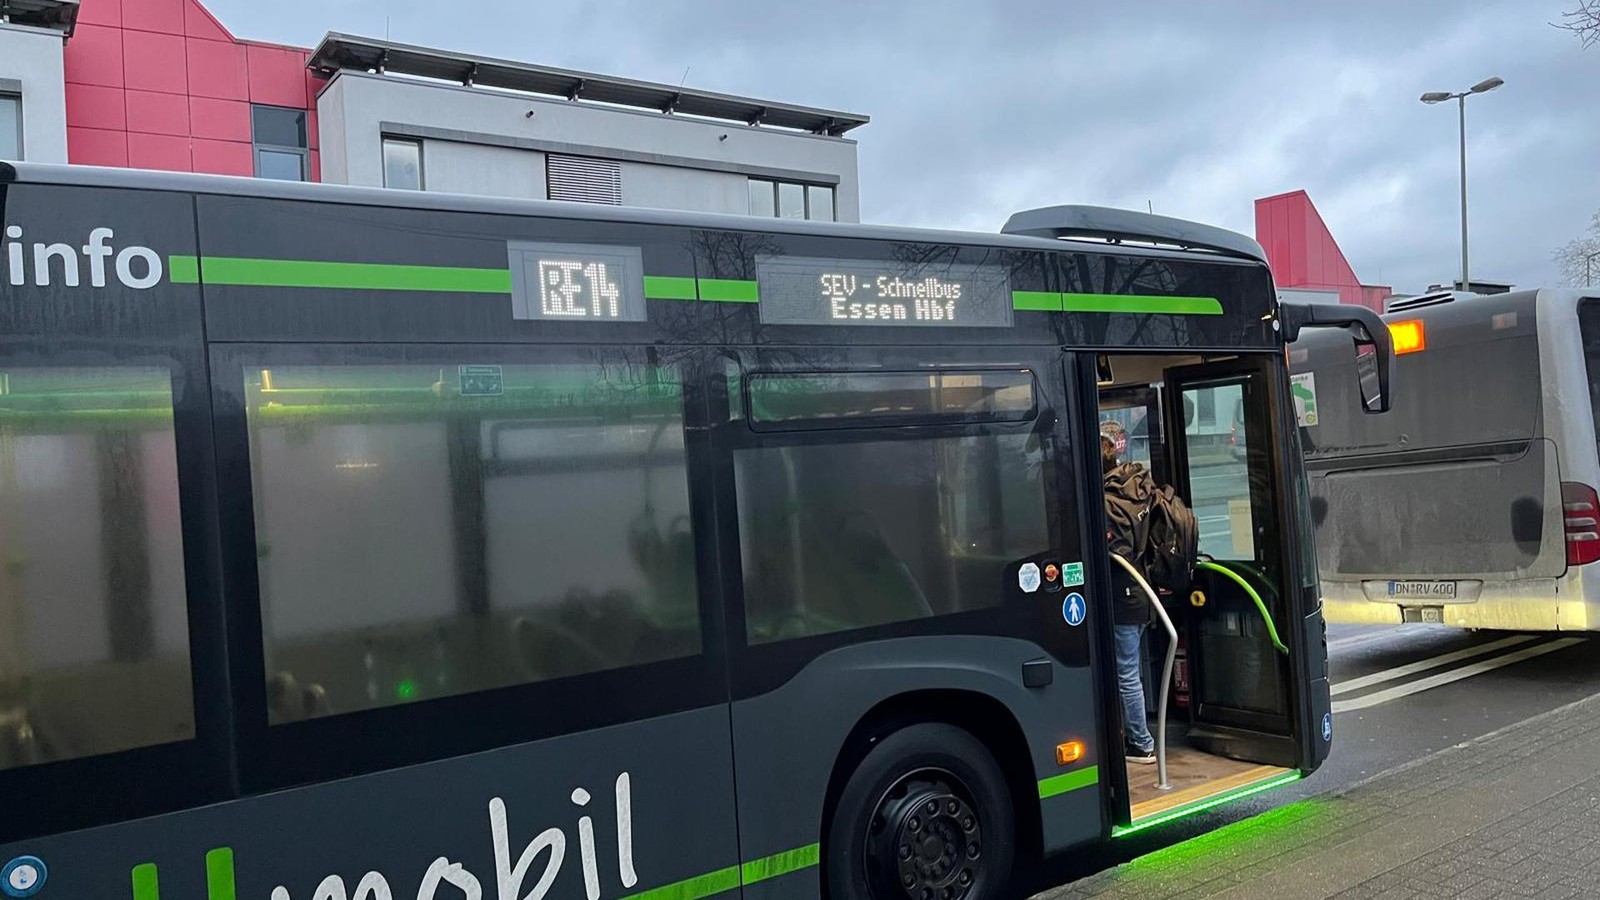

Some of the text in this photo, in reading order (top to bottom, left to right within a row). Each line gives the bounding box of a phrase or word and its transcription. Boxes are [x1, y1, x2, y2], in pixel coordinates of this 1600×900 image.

[6, 225, 163, 289] info
[539, 259, 619, 317] RE14
[820, 273, 856, 296] SEV
[876, 276, 962, 299] Schnellbus
[831, 297, 955, 320] Essen Hbf
[1432, 583, 1453, 594] 400
